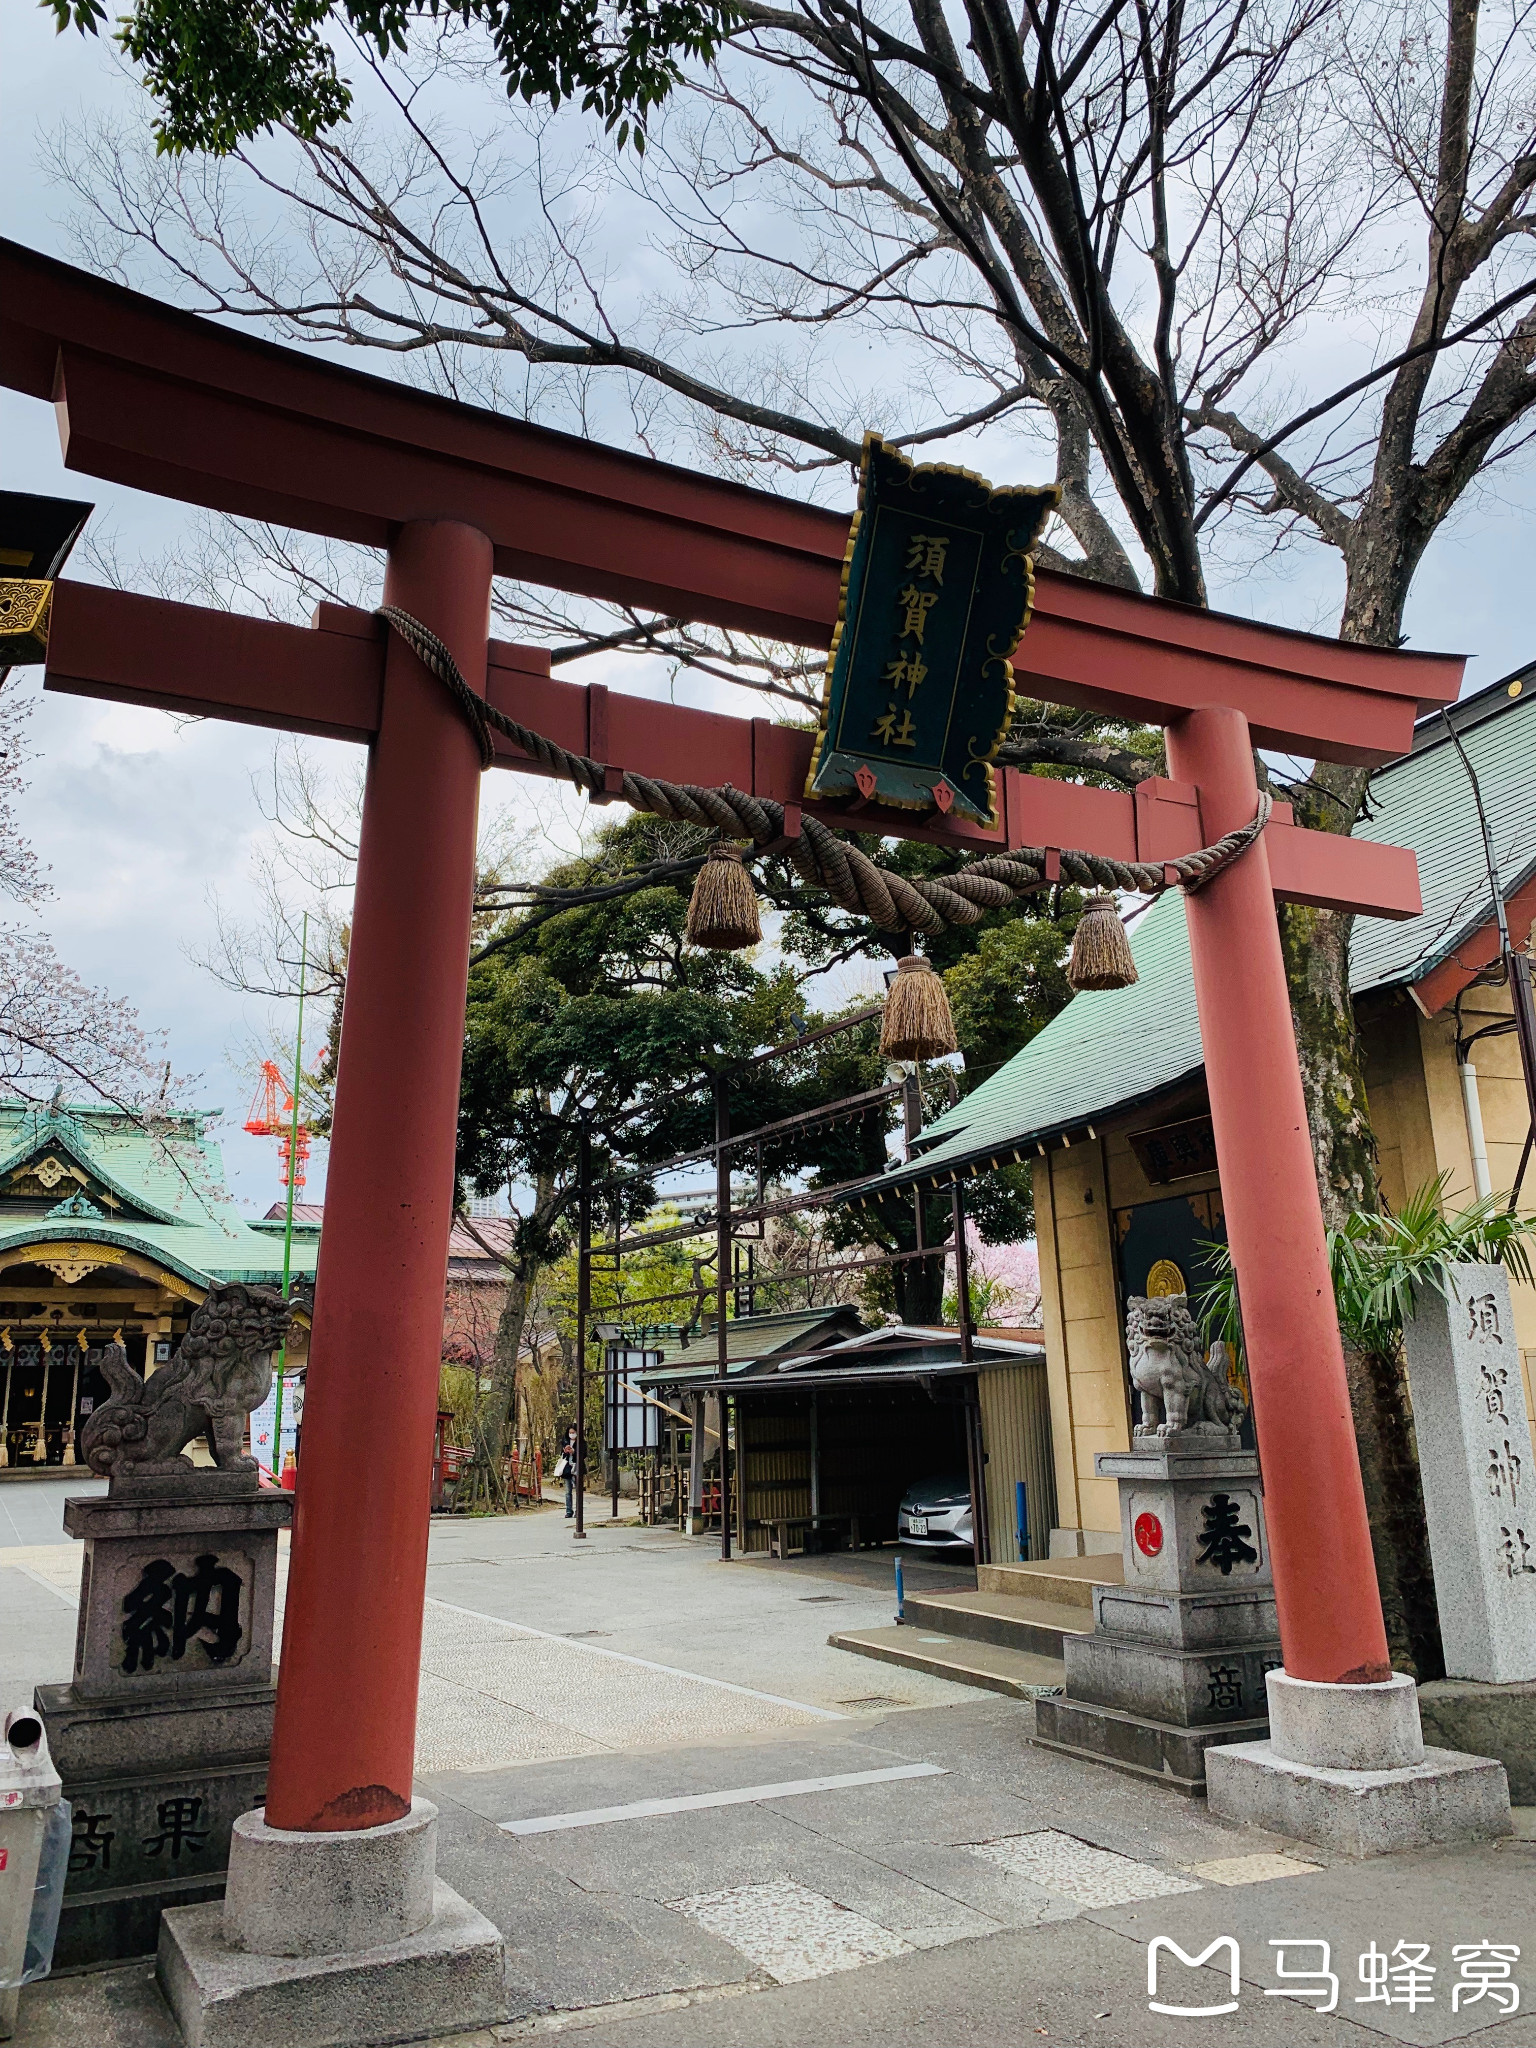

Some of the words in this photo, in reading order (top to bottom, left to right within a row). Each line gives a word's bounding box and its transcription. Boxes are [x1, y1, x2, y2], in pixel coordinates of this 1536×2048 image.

[869, 532, 951, 748] 須賀神社
[1465, 1292, 1536, 1581] 須賀神社
[121, 1553, 243, 1673] 納
[1195, 1493, 1258, 1575] 奉
